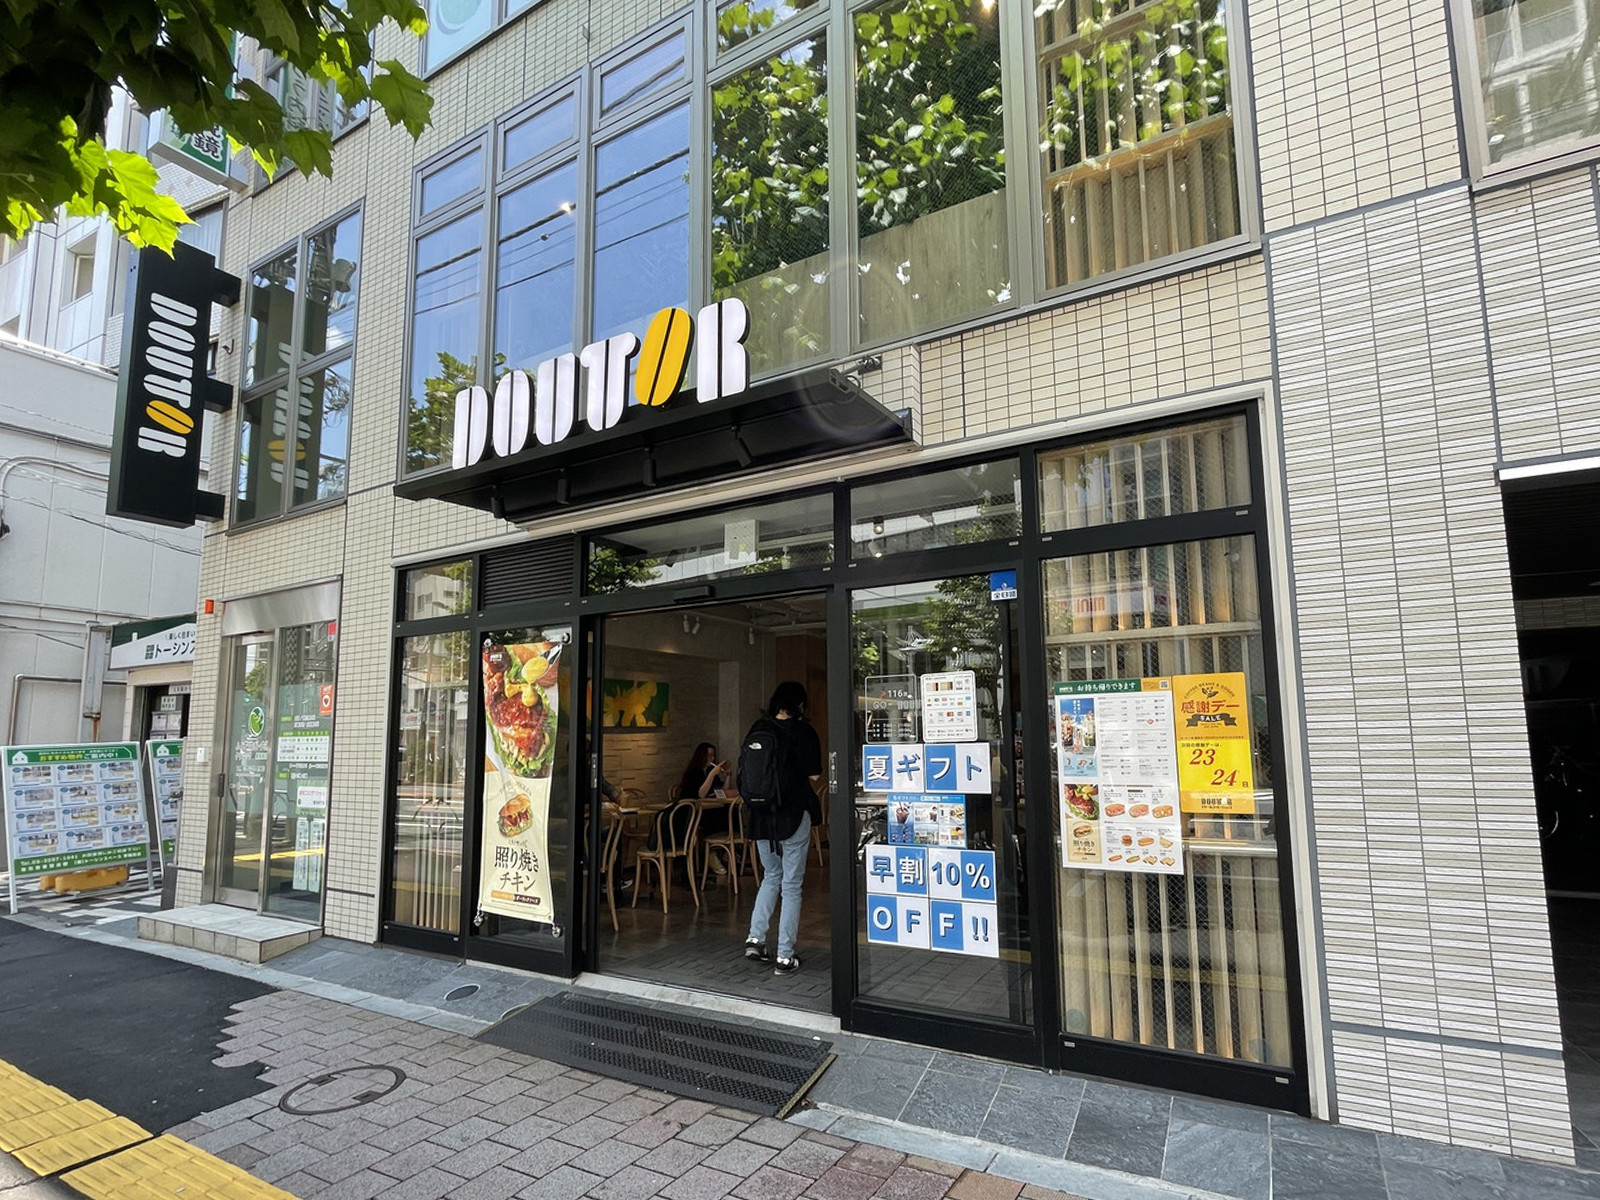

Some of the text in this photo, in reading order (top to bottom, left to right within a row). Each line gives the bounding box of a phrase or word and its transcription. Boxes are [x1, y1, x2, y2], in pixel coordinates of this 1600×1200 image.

[137, 292, 198, 458] DOUTOR
[452, 297, 750, 470] DOUTOR
[1077, 682, 1136, 692] お持ち帰りできます
[1181, 699, 1240, 714] 感謝デー
[866, 753, 983, 783] 夏ギフト
[1189, 748, 1216, 766] 23
[1211, 769, 1240, 787] 24
[1201, 798, 1233, 806] DOUTR
[494, 845, 540, 872] 照り焼き
[500, 871, 536, 893] チキン
[870, 856, 991, 891] 早割10%
[872, 905, 990, 943] OFF!!
